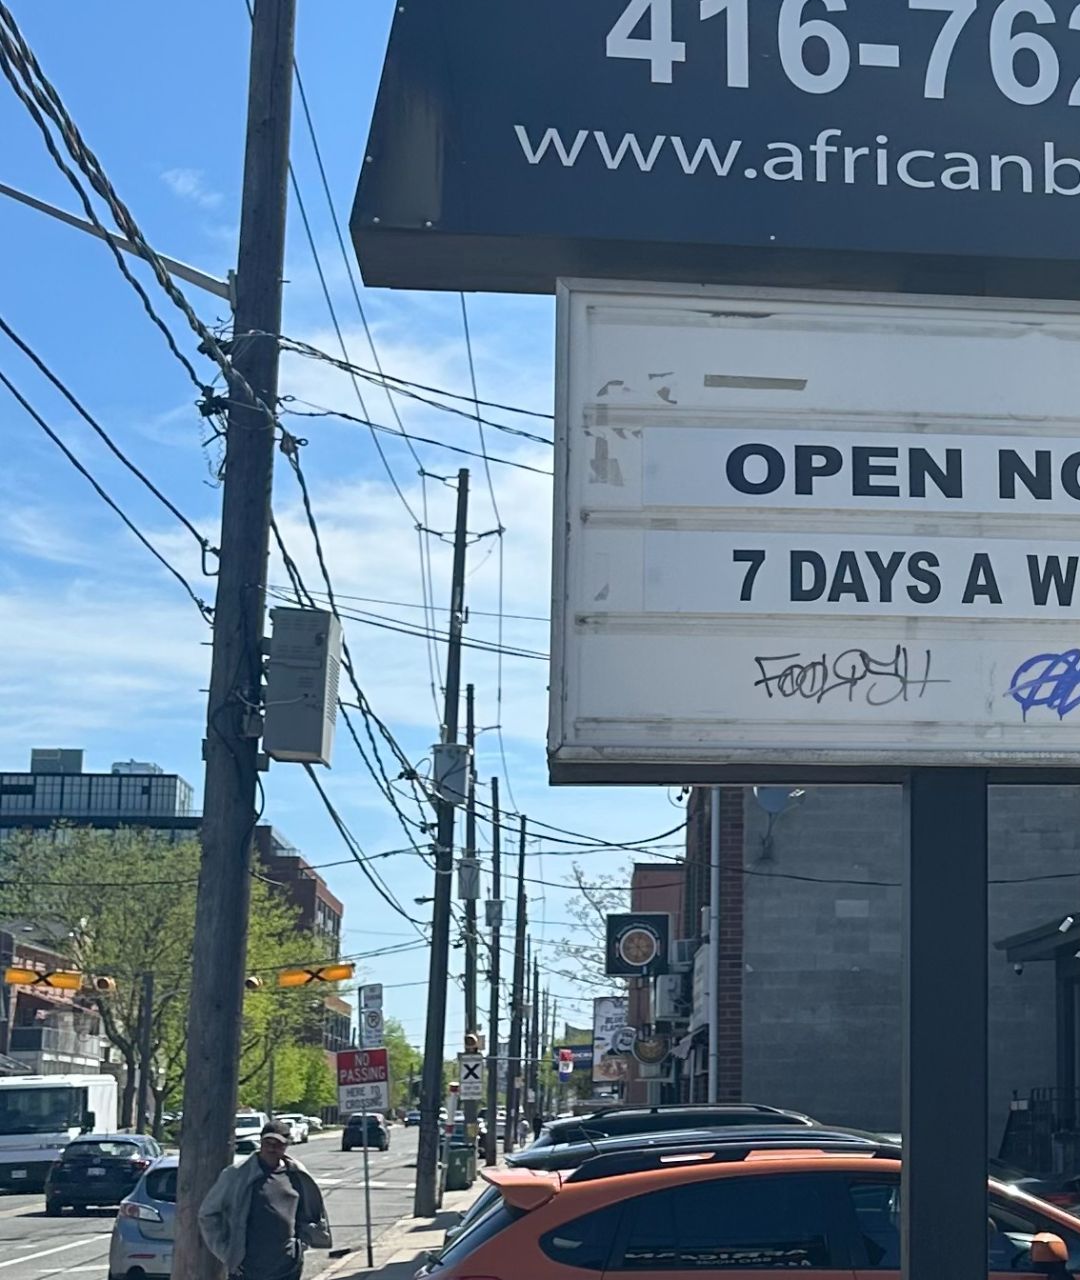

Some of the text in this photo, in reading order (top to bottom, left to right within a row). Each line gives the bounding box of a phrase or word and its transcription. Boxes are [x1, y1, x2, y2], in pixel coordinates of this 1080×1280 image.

[724, 441, 964, 500] OPEN
[731, 549, 767, 602] 7
[789, 550, 943, 605] DAYS
[961, 553, 1002, 605] A
[340, 1065, 386, 1082] PASSING
[354, 1052, 370, 1067] NO
